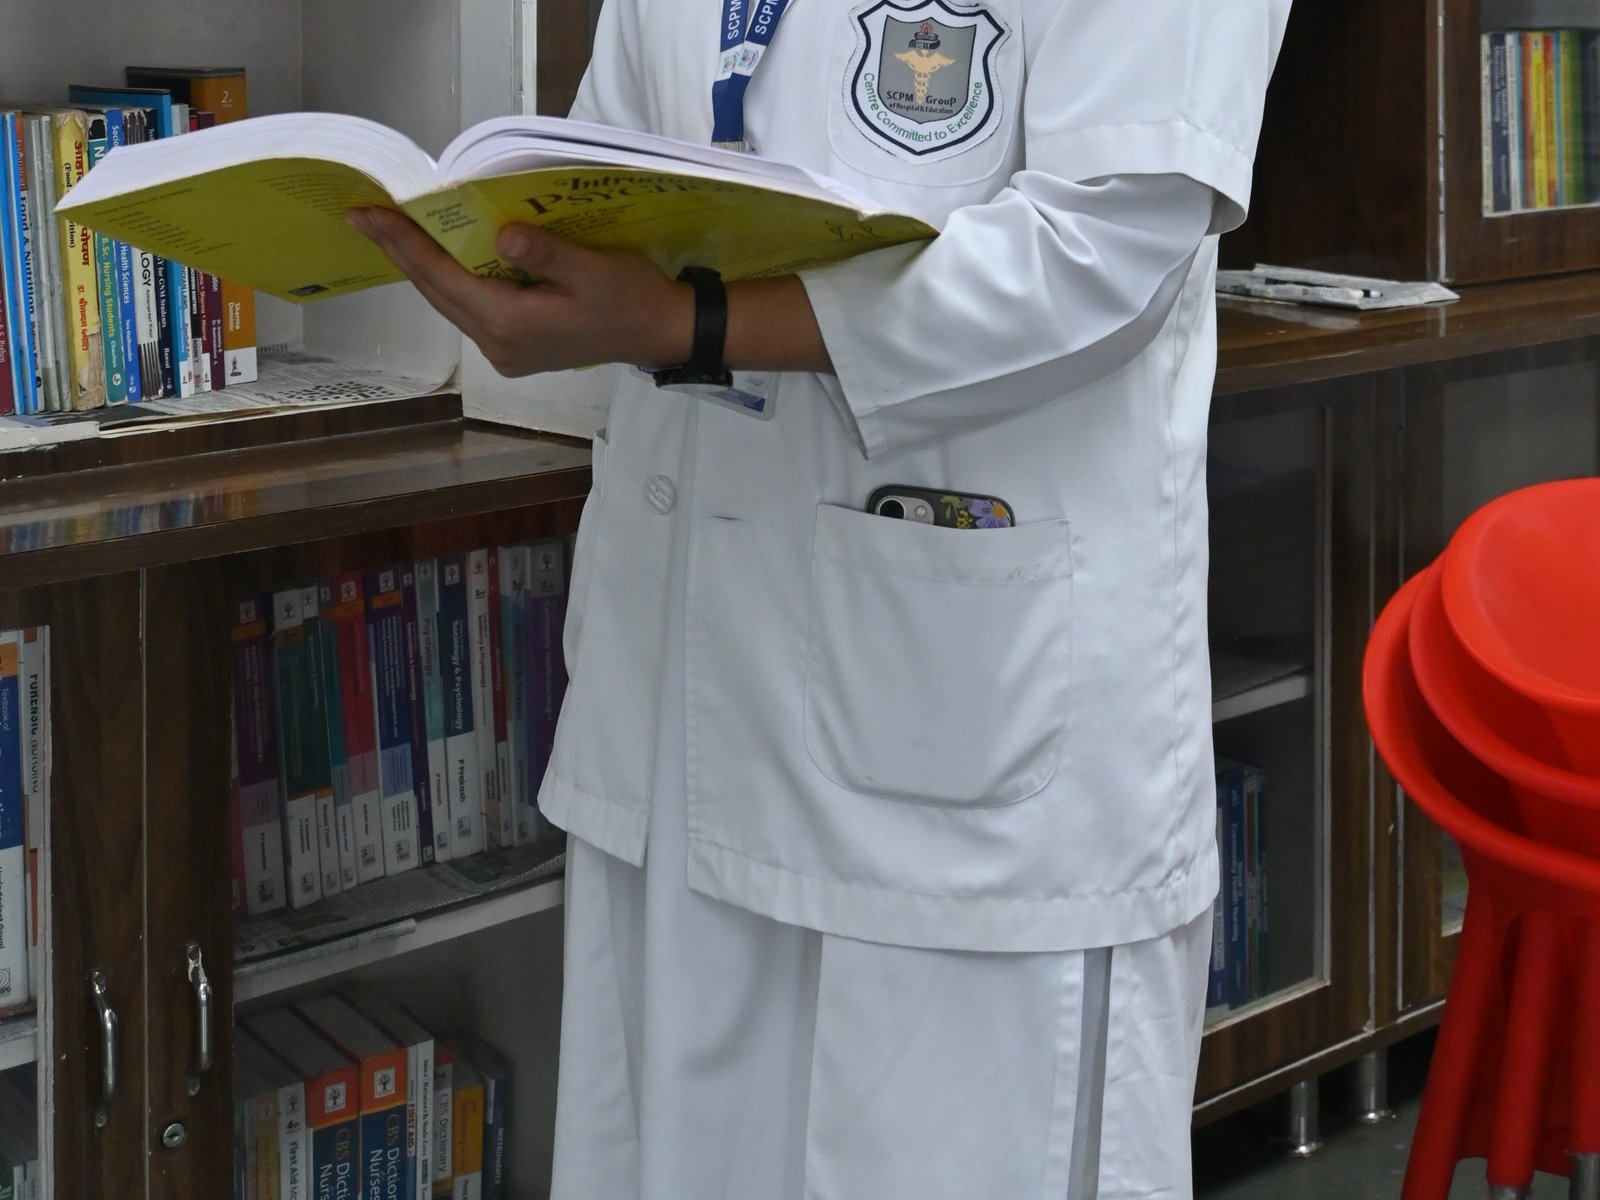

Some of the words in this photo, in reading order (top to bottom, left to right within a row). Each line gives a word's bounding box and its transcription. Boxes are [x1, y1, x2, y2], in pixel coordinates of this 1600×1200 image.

[864, 72, 880, 112] Centre
[876, 110, 932, 142] Committed
[934, 130, 947, 141] to
[946, 81, 983, 134] Excellence
[886, 90, 914, 102] SCPM
[64, 162, 73, 188] (Food
[20, 196, 30, 232] Food
[101, 237, 109, 259] B.Sc.
[120, 246, 129, 270] Health
[103, 262, 112, 296] Nursing
[122, 272, 131, 304] Sciences
[158, 278, 166, 299] GNM
[106, 298, 116, 338] Students
[159, 300, 168, 328] Students
[110, 340, 118, 369] Chauhan
[423, 617, 433, 677] Psychology
[451, 620, 460, 667] Sociology
[452, 675, 464, 731] Psychology
[458, 767, 467, 803] Prakash
[335, 1128, 350, 1160] CBS
[386, 1113, 400, 1146] CBS
[407, 1130, 415, 1148] AID
[437, 1118, 449, 1172] Dictionary
[289, 1141, 298, 1166] First
[289, 1167, 298, 1185] Aid
